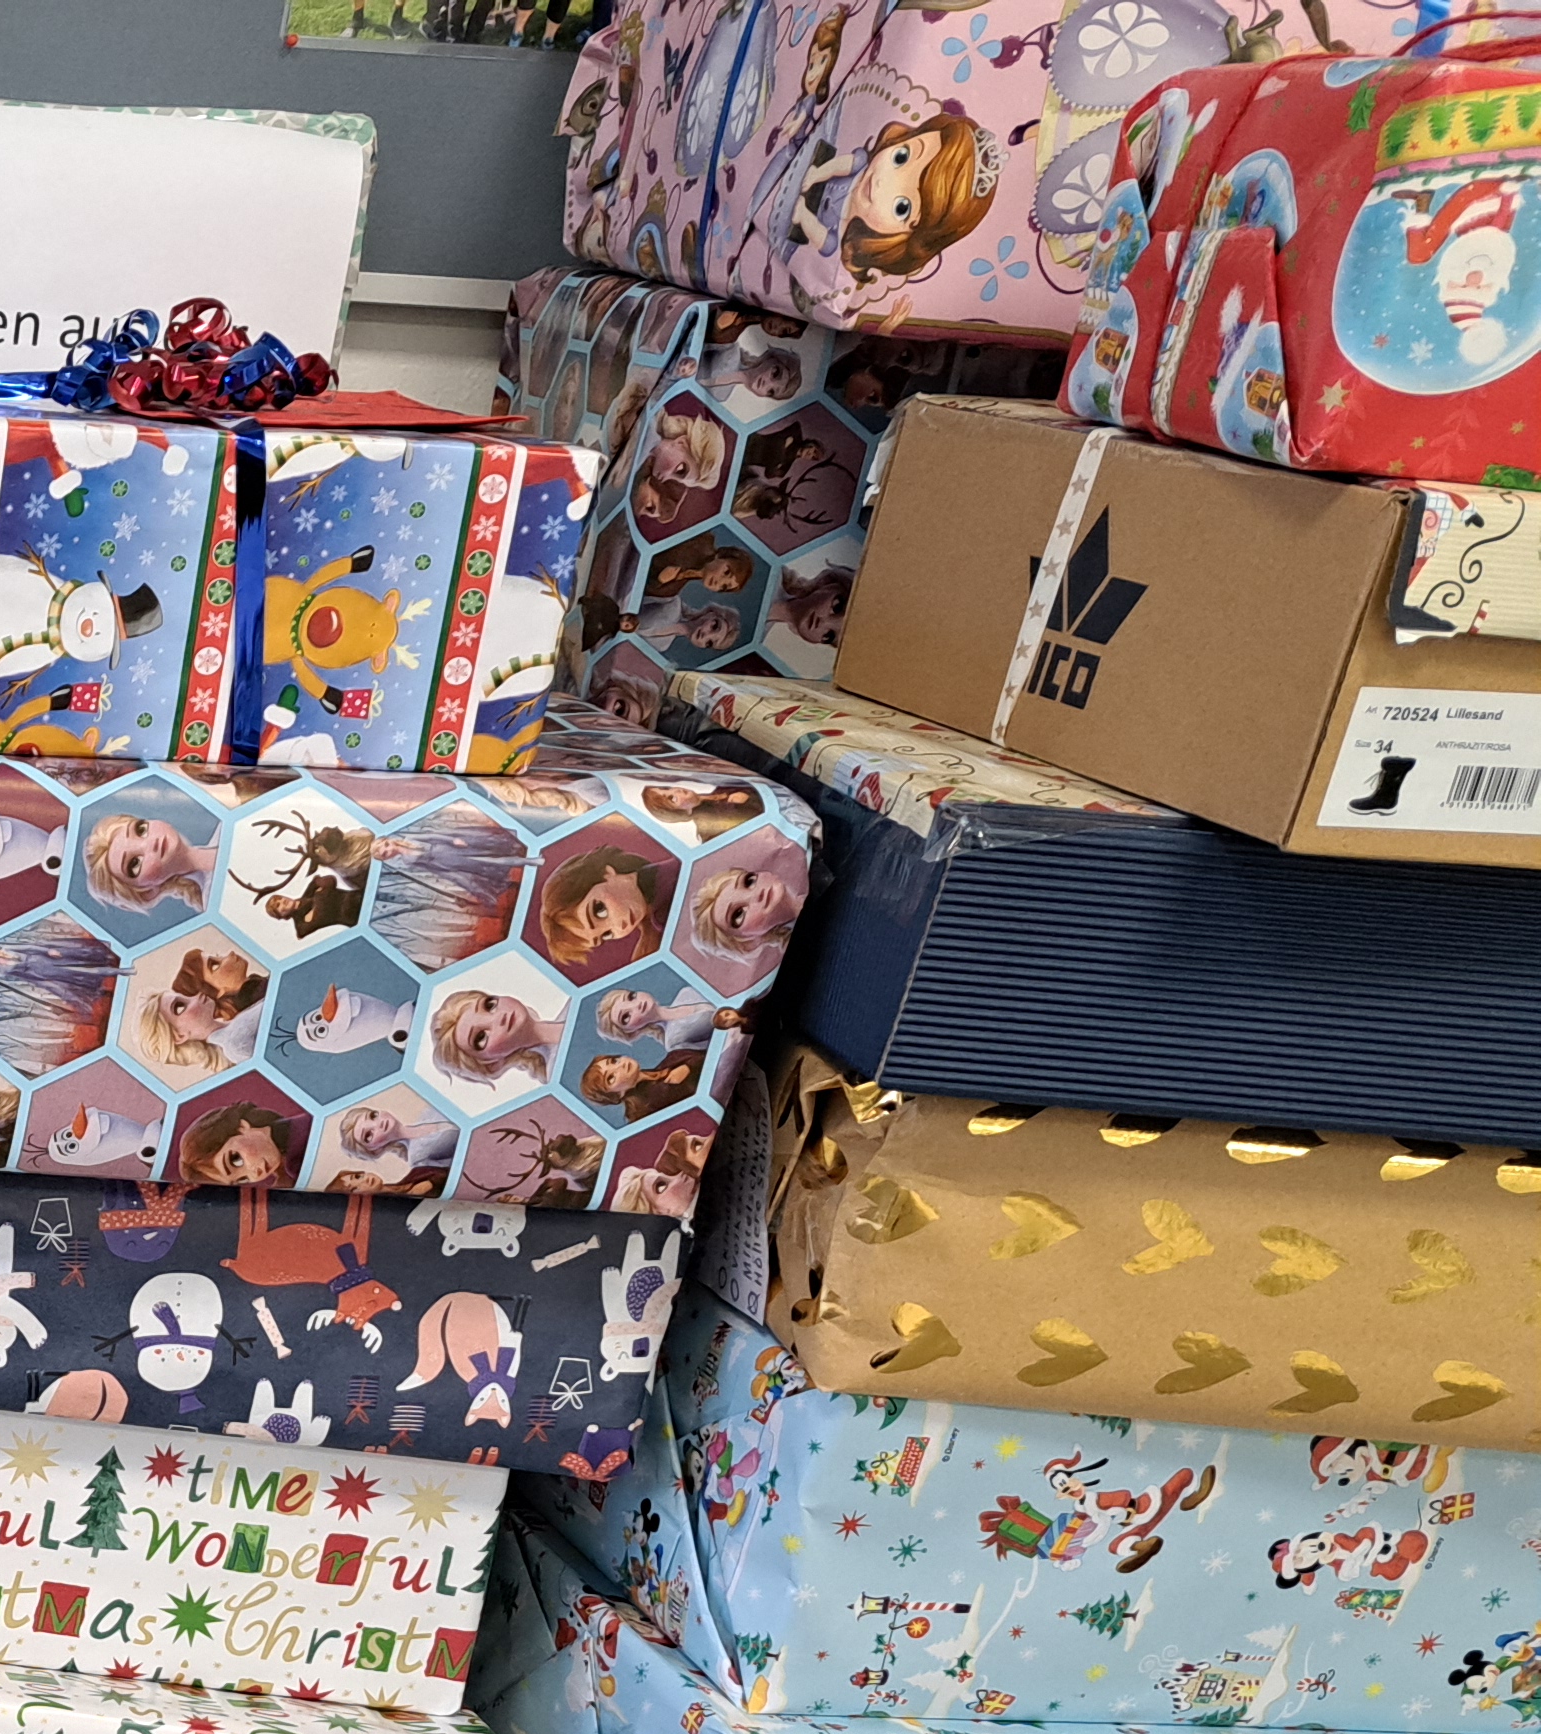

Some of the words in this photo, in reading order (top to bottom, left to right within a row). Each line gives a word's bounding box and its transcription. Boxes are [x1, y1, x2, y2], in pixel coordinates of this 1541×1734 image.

[60, 315, 147, 350] au
[1382, 706, 1440, 722] 720524
[1446, 707, 1504, 721] Lillesand
[1374, 740, 1394, 754] 34
